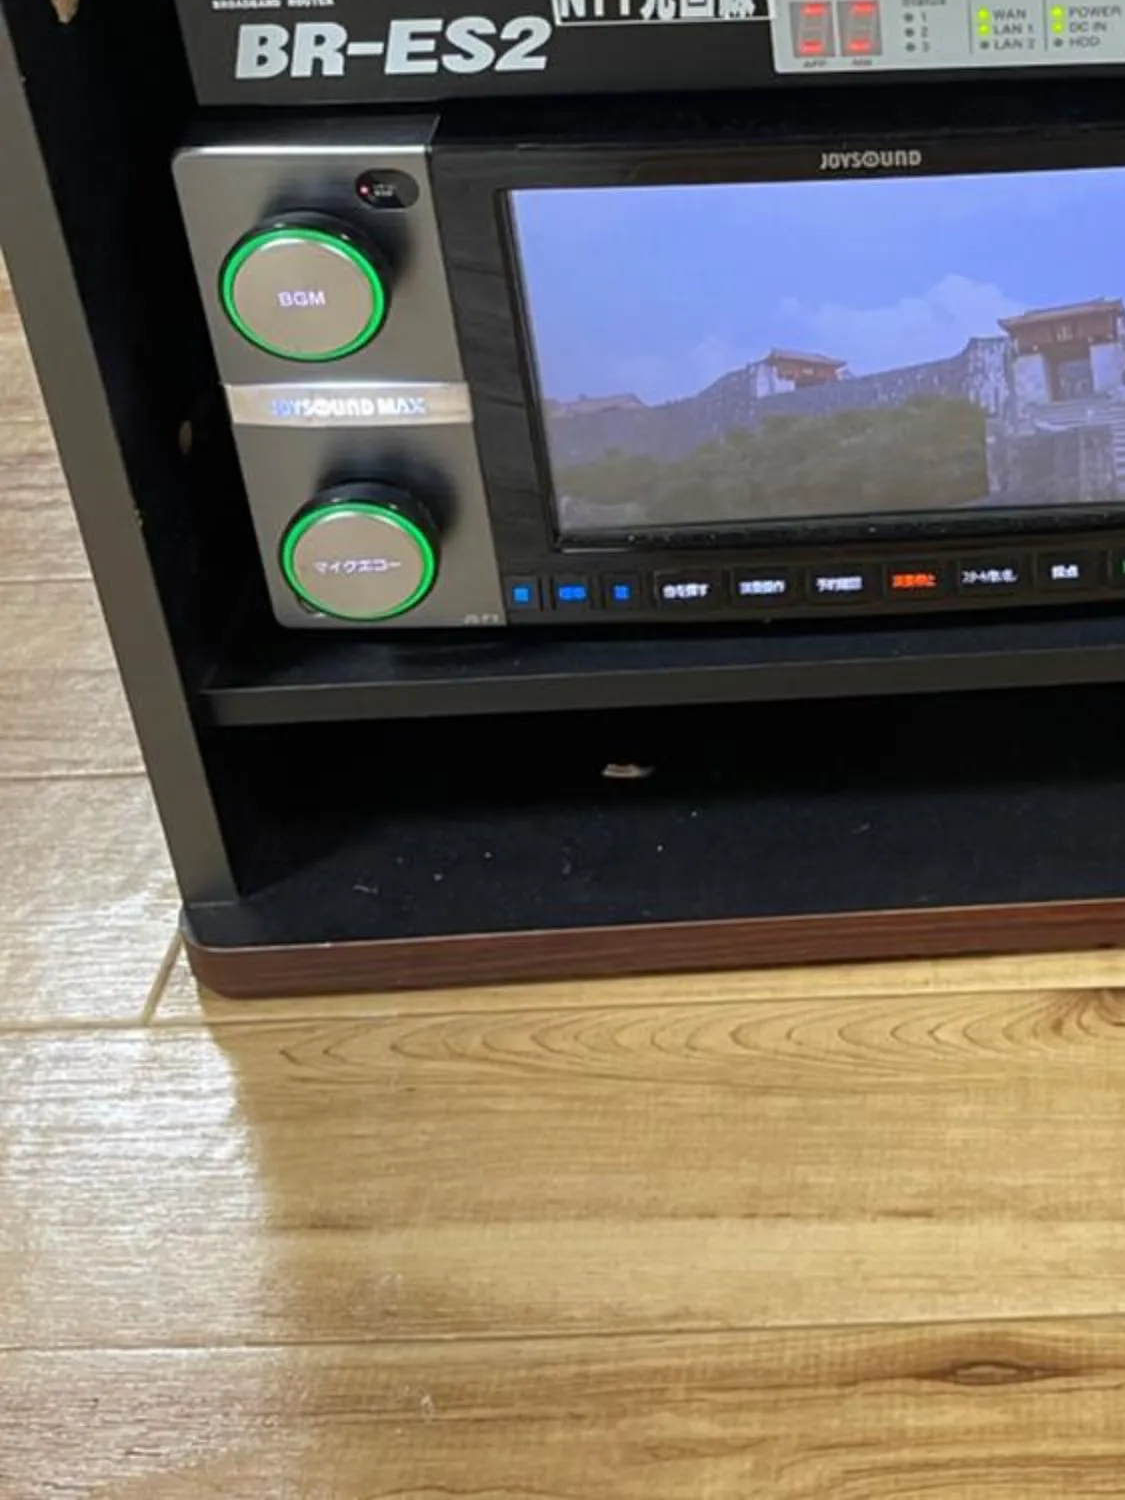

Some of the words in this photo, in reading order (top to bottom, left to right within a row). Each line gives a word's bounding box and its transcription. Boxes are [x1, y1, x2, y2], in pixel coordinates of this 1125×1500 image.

[992, 8, 1027, 21] WAN
[1068, 6, 1121, 18] POWER
[993, 24, 1023, 36] LAN
[1068, 21, 1089, 33] DC
[1092, 21, 1107, 33] IN
[234, 16, 553, 81] BR-ES2
[994, 38, 1023, 51] LAN
[1069, 36, 1100, 48] HDD
[819, 149, 923, 170] JOYSOUND
[277, 290, 327, 308] BGM
[270, 396, 374, 417] JOYSOUND
[378, 397, 426, 415] MAX
[313, 557, 401, 574] マイクエコー
